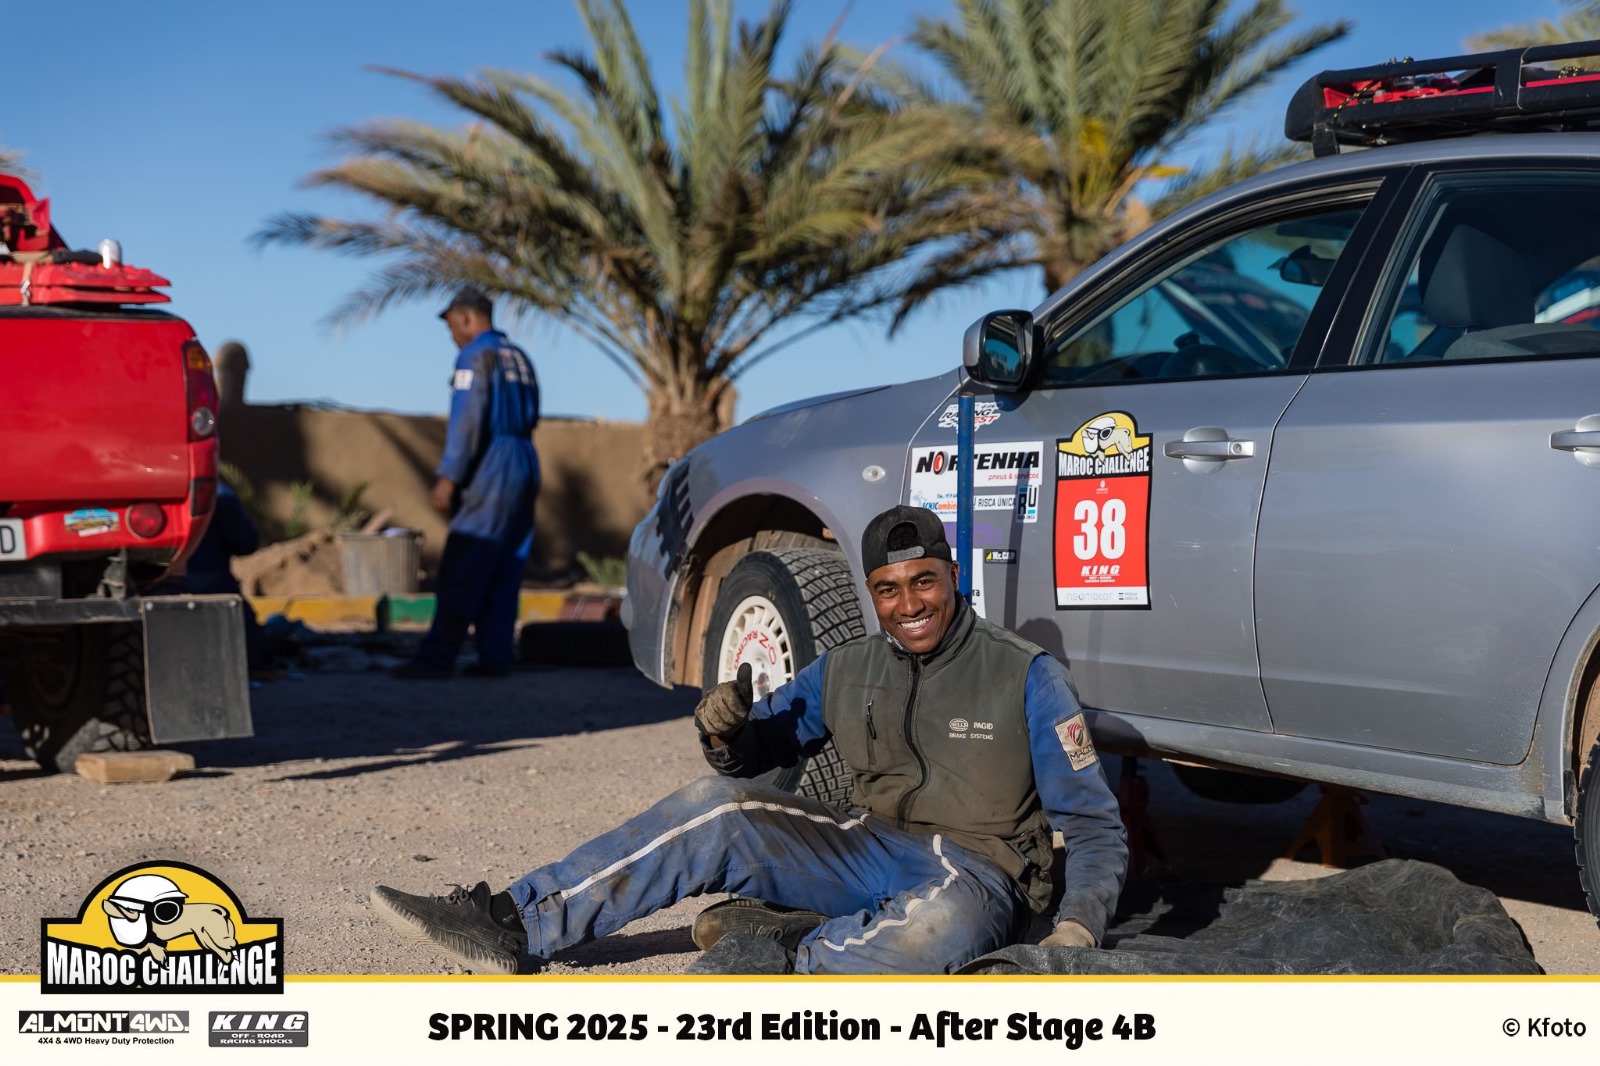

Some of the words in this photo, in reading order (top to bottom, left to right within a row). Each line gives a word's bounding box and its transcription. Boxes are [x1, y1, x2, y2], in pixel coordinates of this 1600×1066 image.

[942, 409, 992, 418] RANG
[915, 451, 1040, 475] NORENHA
[1058, 451, 1093, 477] MAROC
[1095, 446, 1150, 475] CHALLENGE
[978, 498, 996, 507] RISCA
[1073, 498, 1127, 561] 38
[1081, 564, 1120, 576] KING
[973, 722, 994, 730] PAGID
